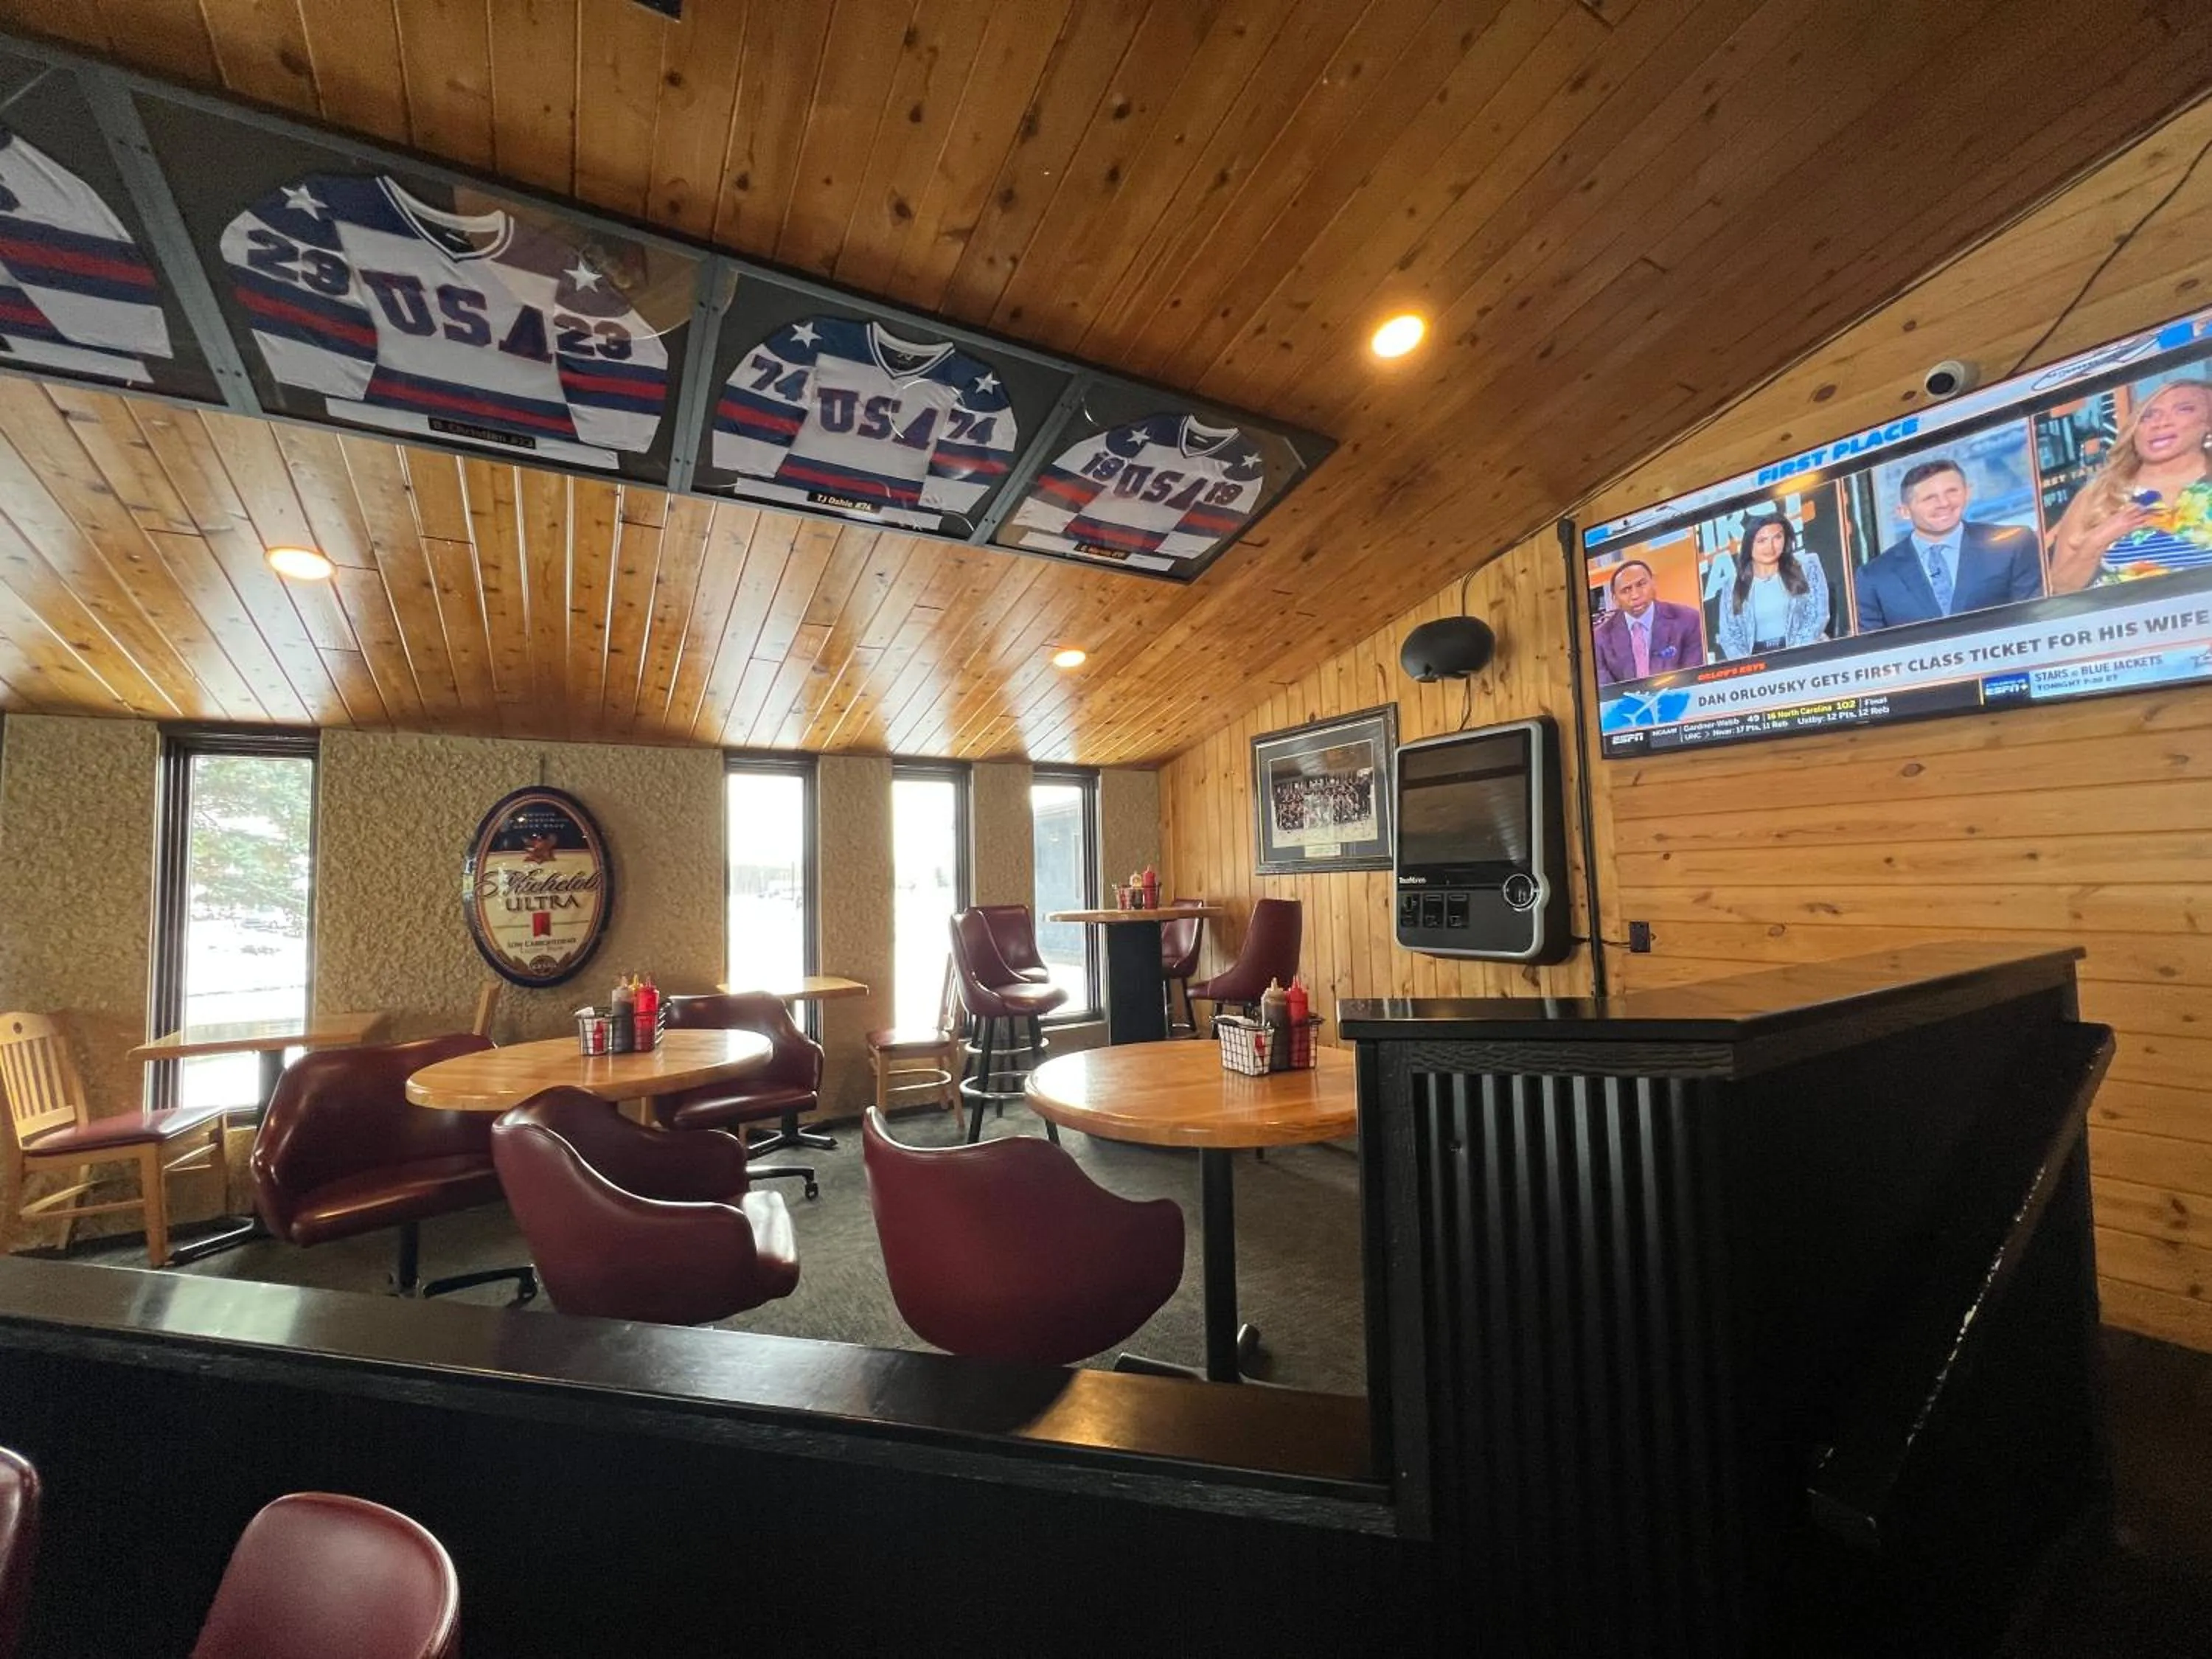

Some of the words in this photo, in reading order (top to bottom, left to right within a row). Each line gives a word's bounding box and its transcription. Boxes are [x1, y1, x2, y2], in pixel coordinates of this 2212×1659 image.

[247, 229, 350, 296] 23
[358, 269, 553, 364] USA
[554, 313, 632, 360] 23
[751, 354, 810, 402] 74
[817, 387, 939, 451] USA
[947, 408, 998, 444] 74
[1079, 451, 1126, 481] 19
[1758, 448, 1828, 485] FIRST
[1832, 417, 1919, 461] PLACE
[1113, 463, 1209, 511] USA
[1203, 481, 1244, 506] 19
[1698, 692, 1726, 707] DAN
[1730, 679, 1806, 701] ORLOVSKY
[1810, 672, 1850, 689] GETS
[1854, 661, 1903, 682] FIRST
[1907, 653, 1964, 672] CLASS
[1969, 639, 2042, 661] TICKET
[2048, 630, 2093, 650] FOR
[2098, 621, 2139, 642] HIS
[2143, 609, 2211, 633] WIFE
[2034, 668, 2068, 682] STARS
[2080, 663, 2110, 675] BLUE
[2114, 655, 2163, 671] JACKETS
[1683, 718, 1740, 732] Gardner-Webb
[1747, 714, 1760, 723] 49
[1778, 709, 1799, 719] North
[1800, 703, 1833, 715] Carolina
[1836, 700, 1857, 711] 102
[1864, 697, 1888, 706] Final
[1871, 705, 1891, 715] Reb
[1612, 732, 1644, 745] ESPN
[505, 894, 580, 912] ULTRA
